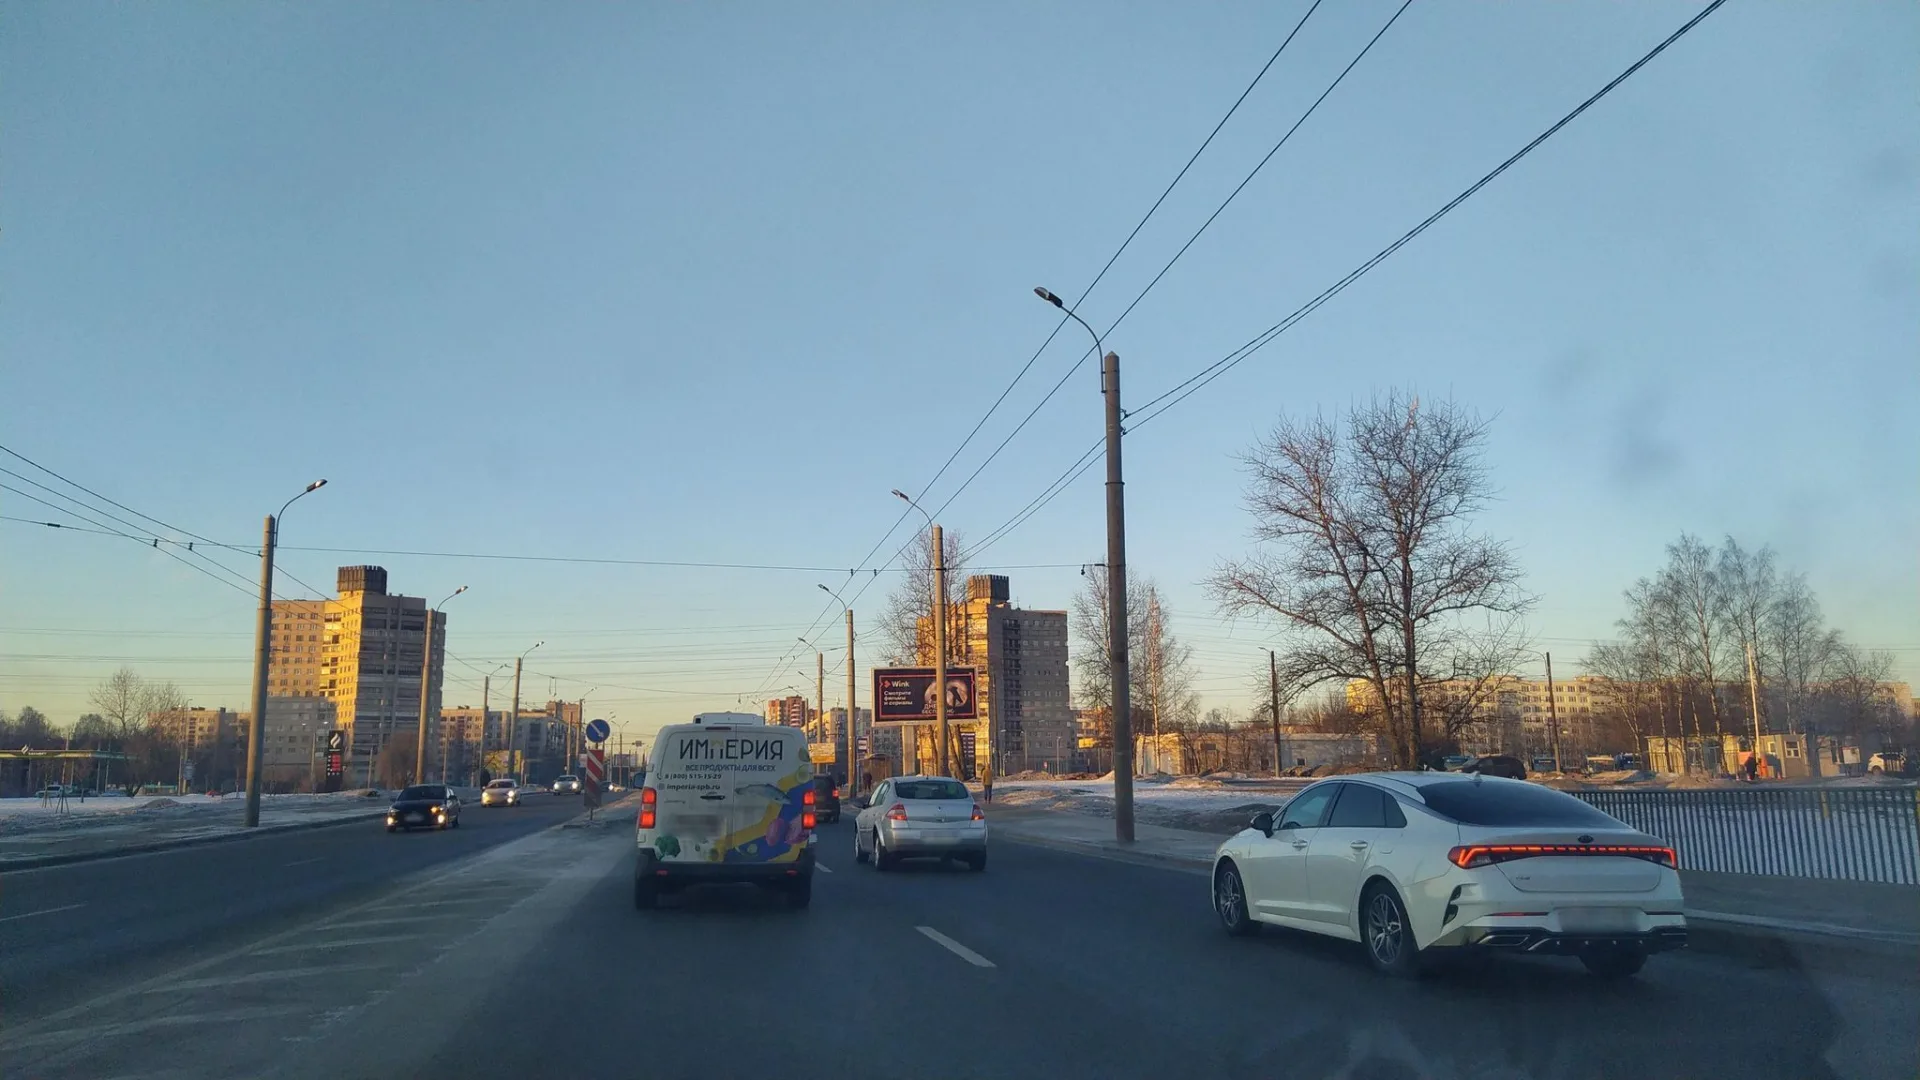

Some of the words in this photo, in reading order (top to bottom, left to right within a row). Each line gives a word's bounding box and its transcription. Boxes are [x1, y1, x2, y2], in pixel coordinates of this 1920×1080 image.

[679, 739, 783, 760] ИМПЕРИЯ
[685, 764, 698, 772] ВСЕ
[700, 764, 740, 772] ПРОДУКТЫ
[741, 764, 757, 773] ДЛЯ
[758, 764, 776, 772] ВСЕХ
